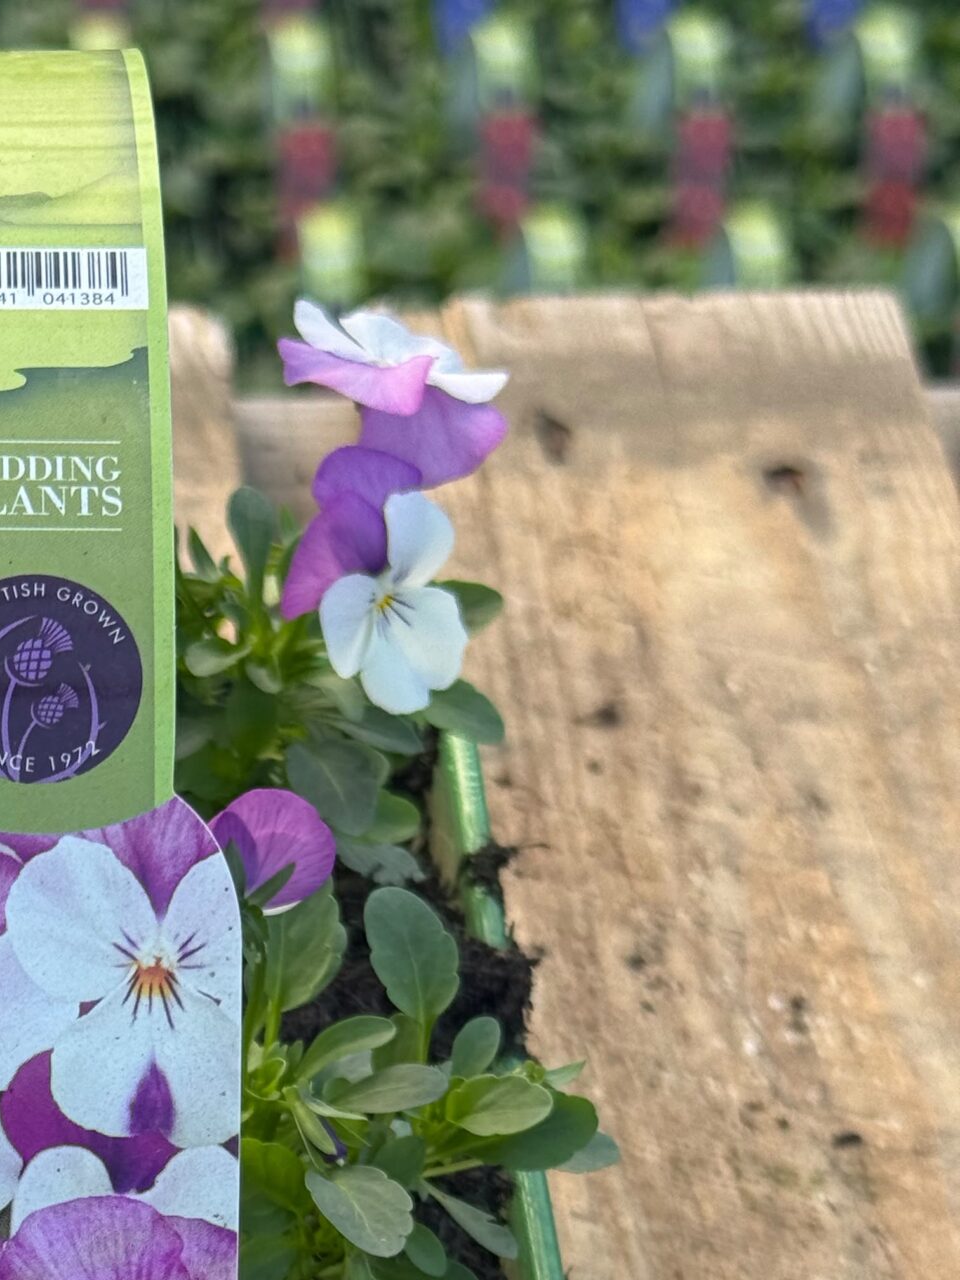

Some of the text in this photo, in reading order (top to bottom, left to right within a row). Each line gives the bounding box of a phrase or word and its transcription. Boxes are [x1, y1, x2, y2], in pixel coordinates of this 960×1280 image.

[42, 292, 116, 305] 041384
[56, 586, 126, 645] GROWN
[48, 740, 101, 772] 1972
